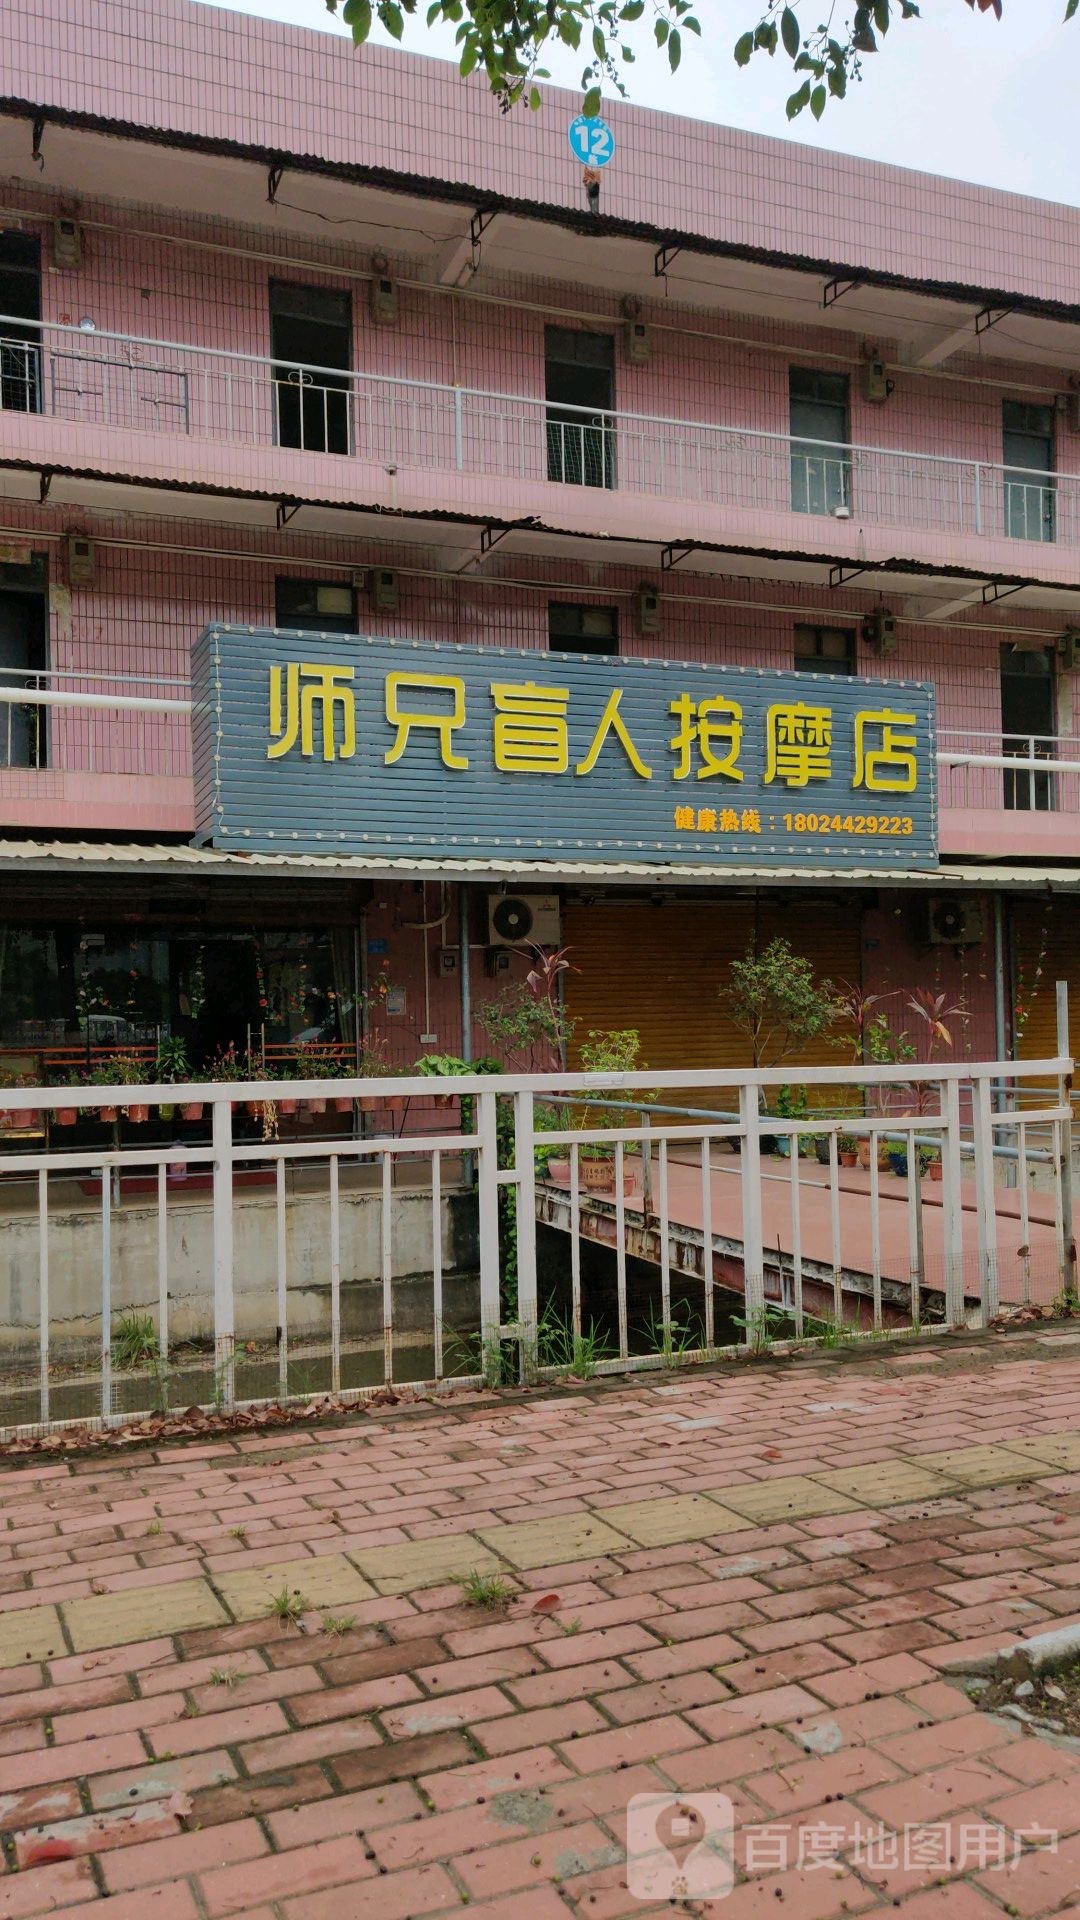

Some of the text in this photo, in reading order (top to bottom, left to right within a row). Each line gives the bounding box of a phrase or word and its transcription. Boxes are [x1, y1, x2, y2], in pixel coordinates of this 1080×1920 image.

[575, 125, 610, 157] 12
[267, 662, 917, 793] 师兄盲人按摩店
